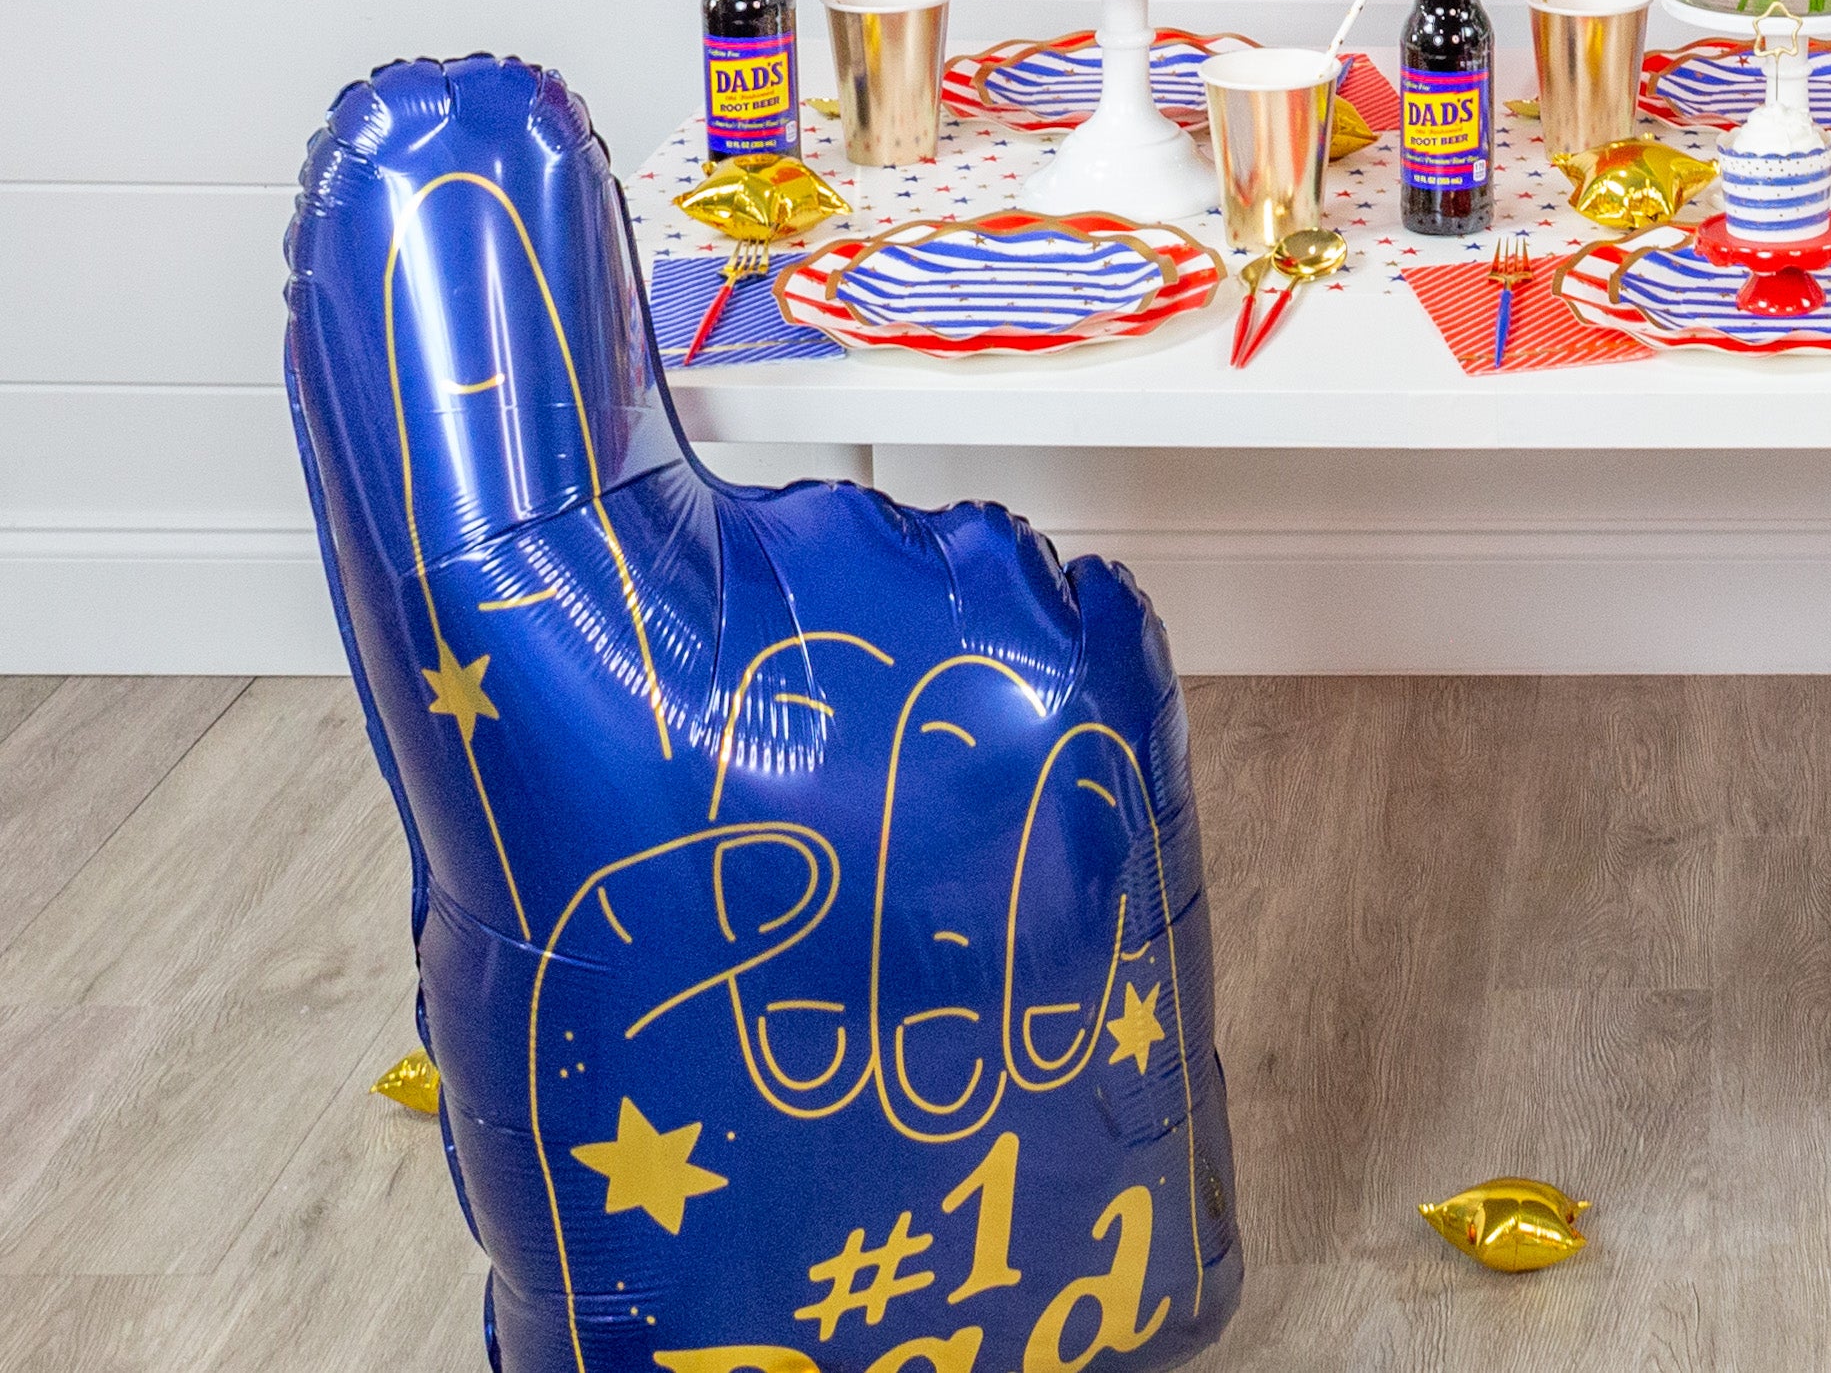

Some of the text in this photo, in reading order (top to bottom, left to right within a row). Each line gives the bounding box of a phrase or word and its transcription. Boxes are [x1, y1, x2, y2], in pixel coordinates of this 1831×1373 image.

[716, 61, 783, 93] DAD'S
[721, 96, 779, 112] ROOT BEER
[1408, 98, 1473, 126] DAD'S
[1411, 134, 1468, 145] ROOT BEER
[795, 1132, 1021, 1341] #1
